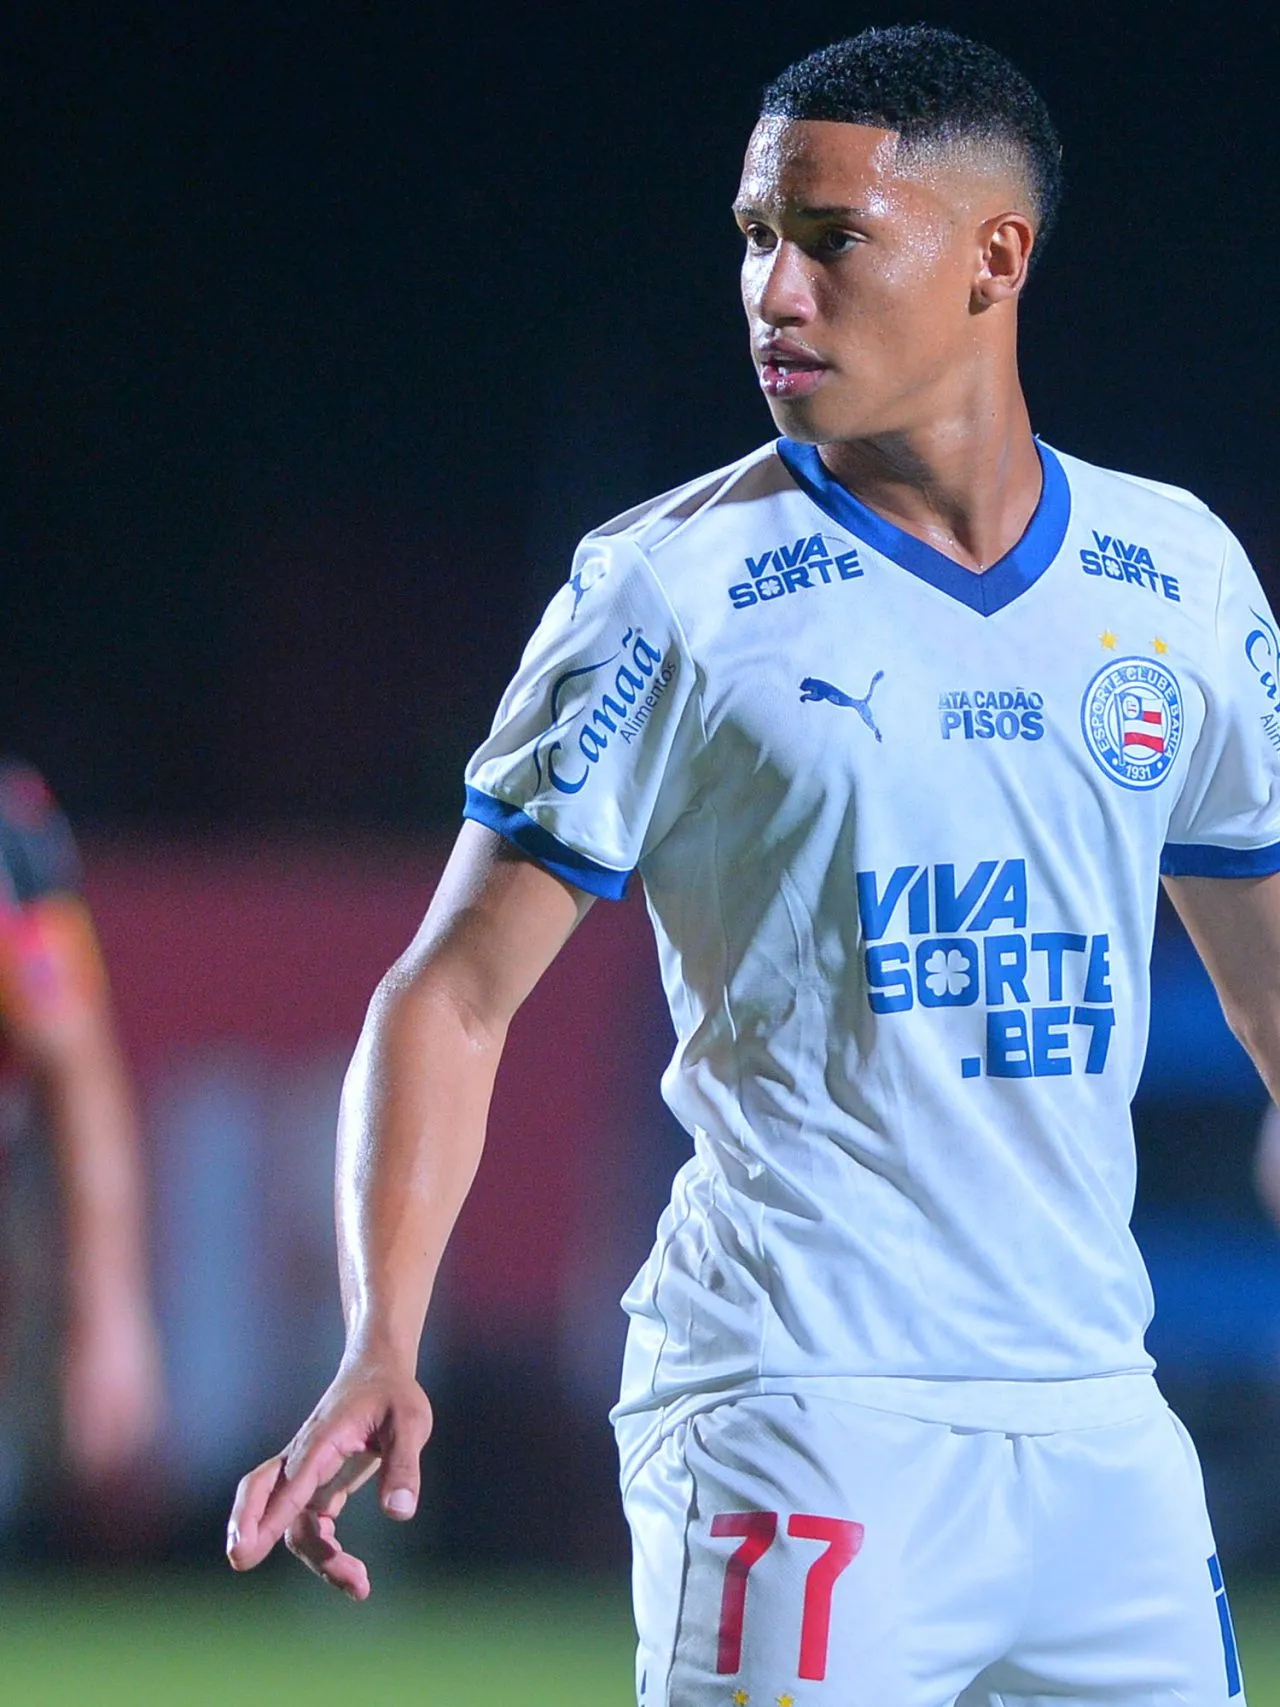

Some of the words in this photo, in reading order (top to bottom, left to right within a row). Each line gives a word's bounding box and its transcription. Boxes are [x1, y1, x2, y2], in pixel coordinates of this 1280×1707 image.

[727, 549, 864, 609] SORTE
[745, 533, 830, 579] VIVA
[1079, 549, 1182, 603] SORTE
[1091, 529, 1156, 571] VIVA
[548, 626, 662, 795] Canaã
[618, 660, 677, 745] Alimentos
[942, 709, 1045, 741] PISOS
[1091, 671, 1124, 753] ESPORTE
[1126, 666, 1176, 704] CLUBE
[1164, 703, 1181, 759] BAHIA
[1125, 764, 1152, 780] 1931
[856, 858, 1028, 940] VIVA
[865, 932, 1113, 1015] SORTE
[960, 1006, 1116, 1079] .BET
[710, 1511, 864, 1681] 77
